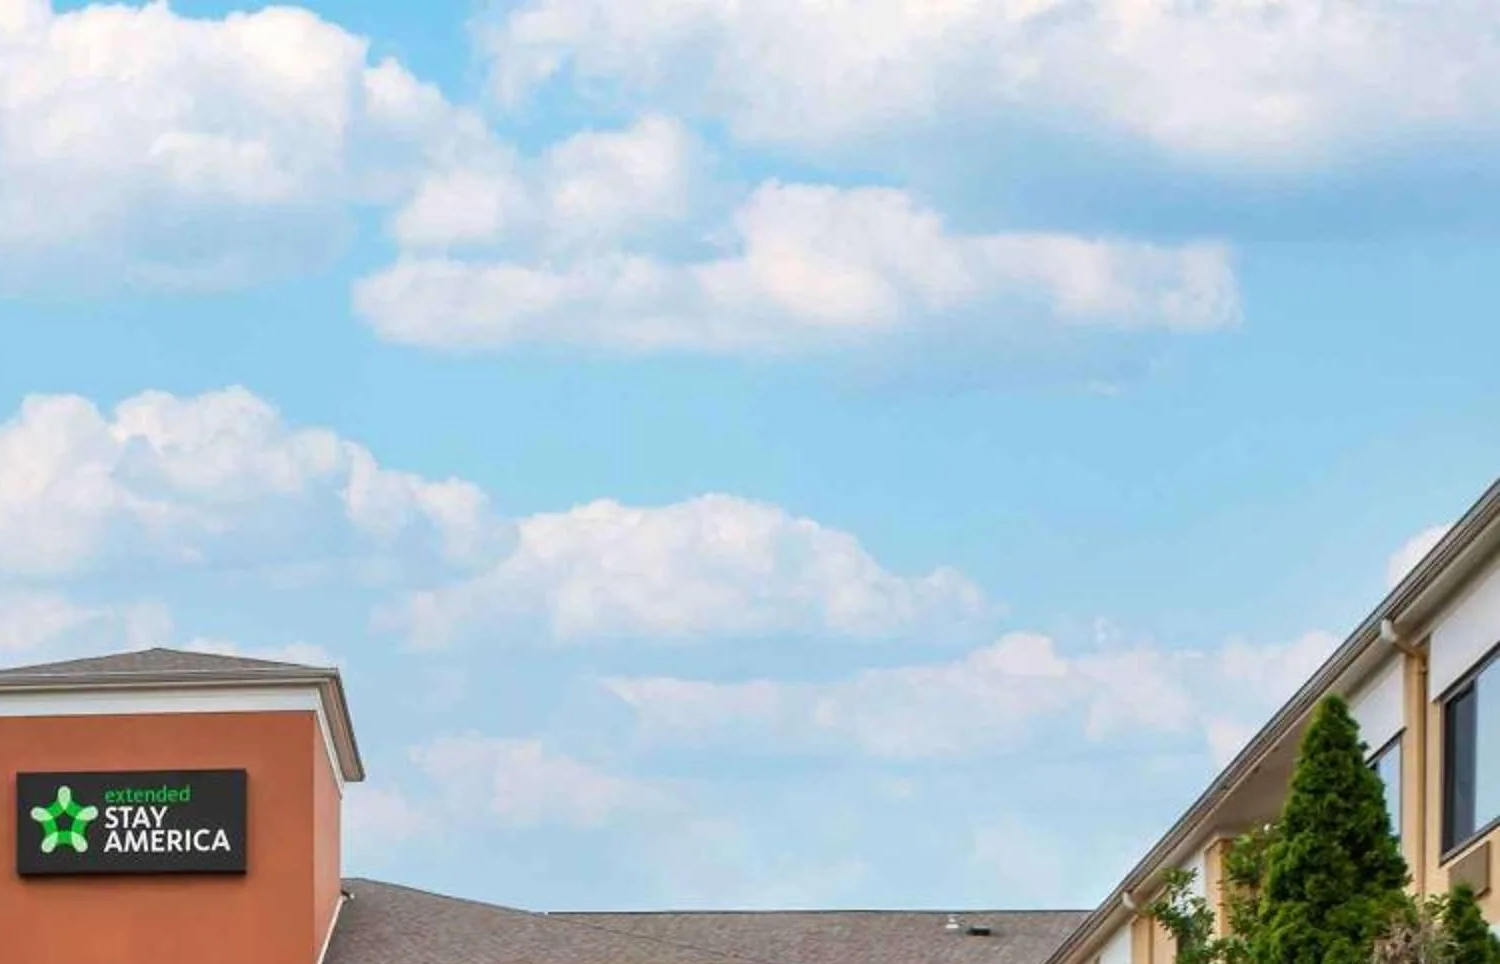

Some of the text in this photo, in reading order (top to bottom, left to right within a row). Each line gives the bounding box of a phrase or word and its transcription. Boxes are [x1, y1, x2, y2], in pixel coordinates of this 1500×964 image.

[104, 785, 191, 803] extended
[104, 806, 168, 829] STAY
[103, 829, 231, 853] AMERICA
